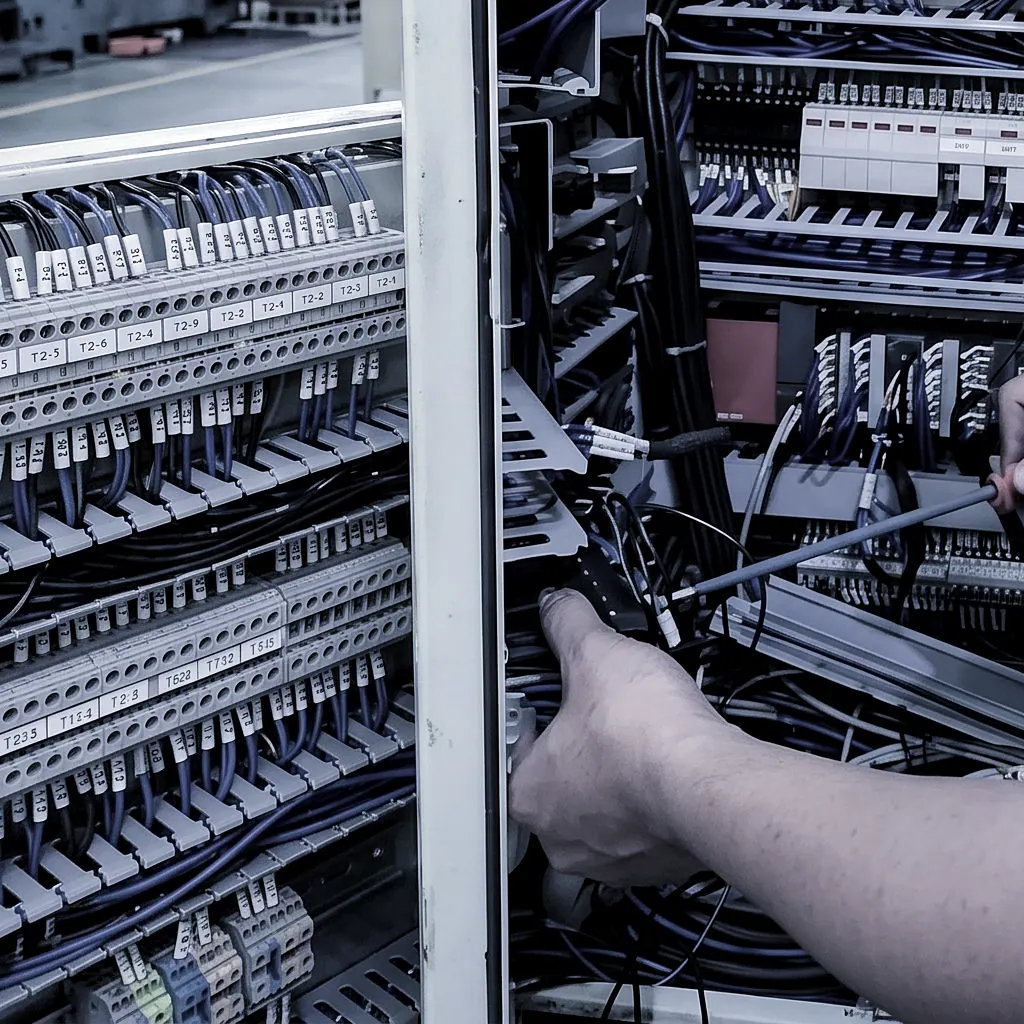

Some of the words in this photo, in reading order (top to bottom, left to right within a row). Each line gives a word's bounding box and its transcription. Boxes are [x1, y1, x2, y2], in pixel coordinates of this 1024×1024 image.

[222, 309, 245, 322] T2-2
[128, 328, 154, 343] T2-4
[80, 338, 108, 353] T2-6
[31, 347, 60, 363] T2-5
[3, 728, 37, 750] T235
